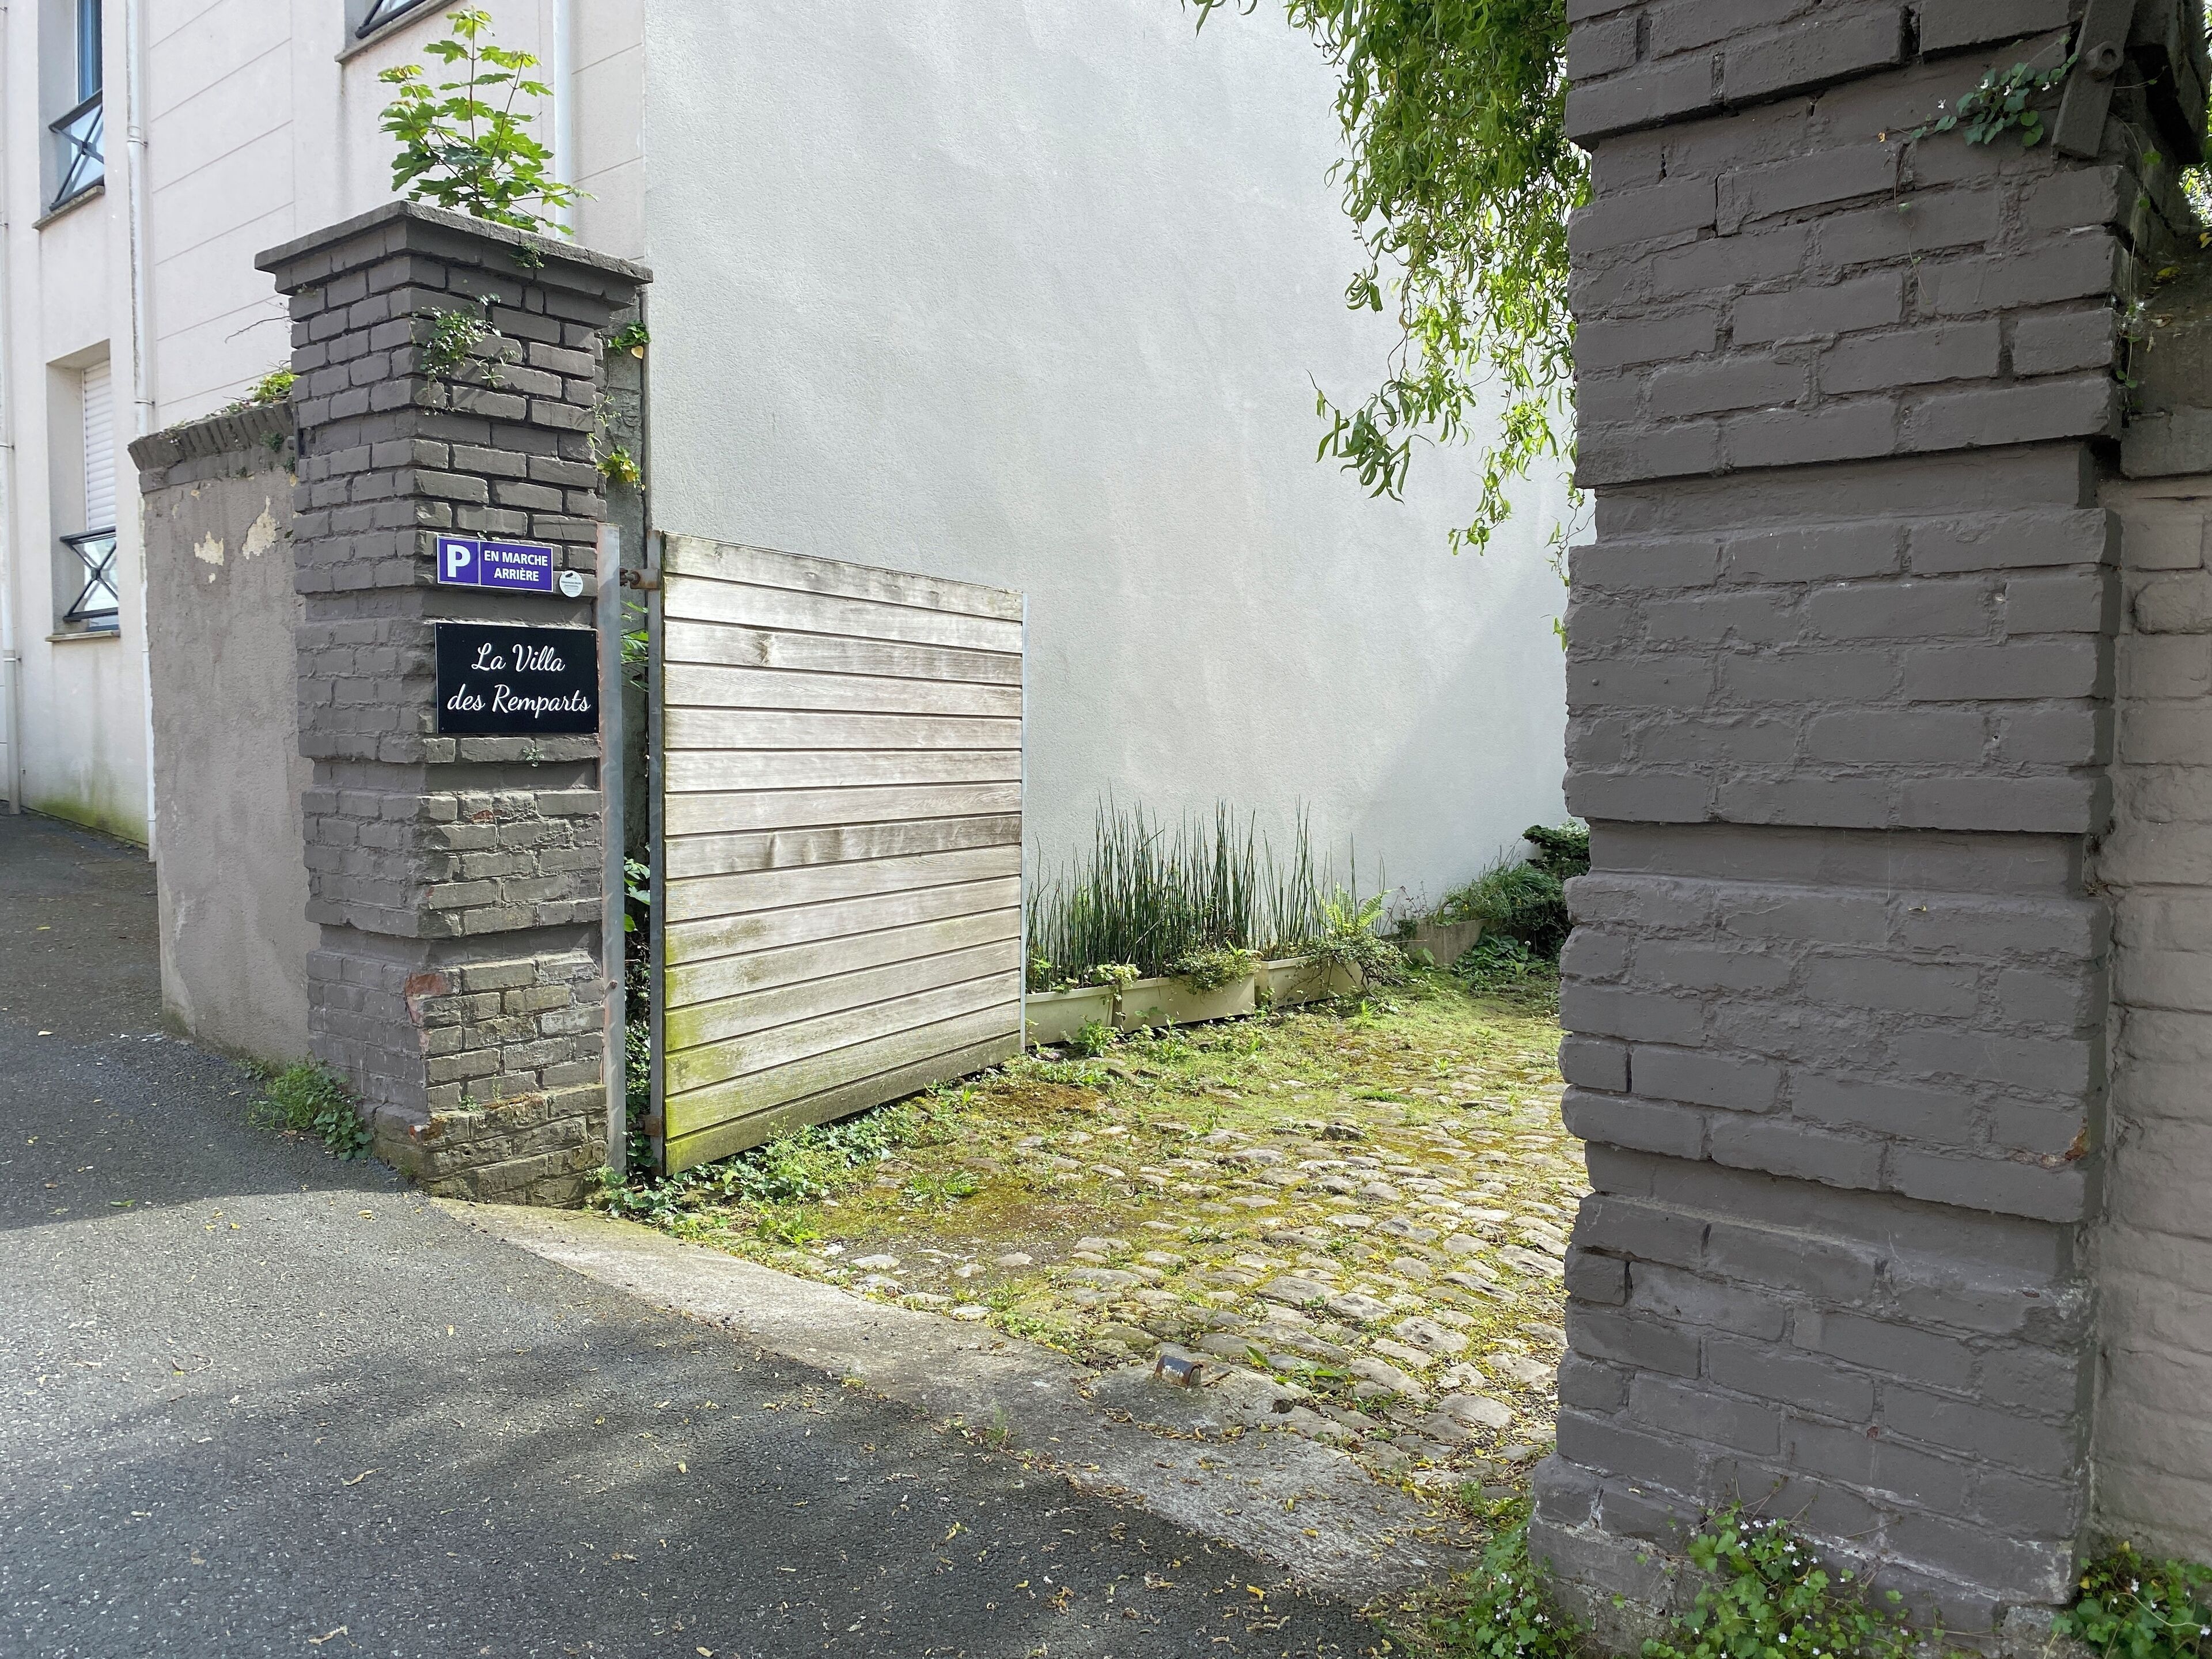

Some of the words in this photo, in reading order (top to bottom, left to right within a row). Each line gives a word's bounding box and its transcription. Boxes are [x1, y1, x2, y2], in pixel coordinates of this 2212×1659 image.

[447, 544, 471, 578] P
[484, 550, 498, 562] EN
[502, 551, 548, 566] MARCHE
[494, 567, 539, 581] ARRIÈRE
[471, 642, 506, 671] La
[512, 643, 566, 672] Villa
[447, 683, 486, 711] des
[492, 684, 591, 719] Remparts
